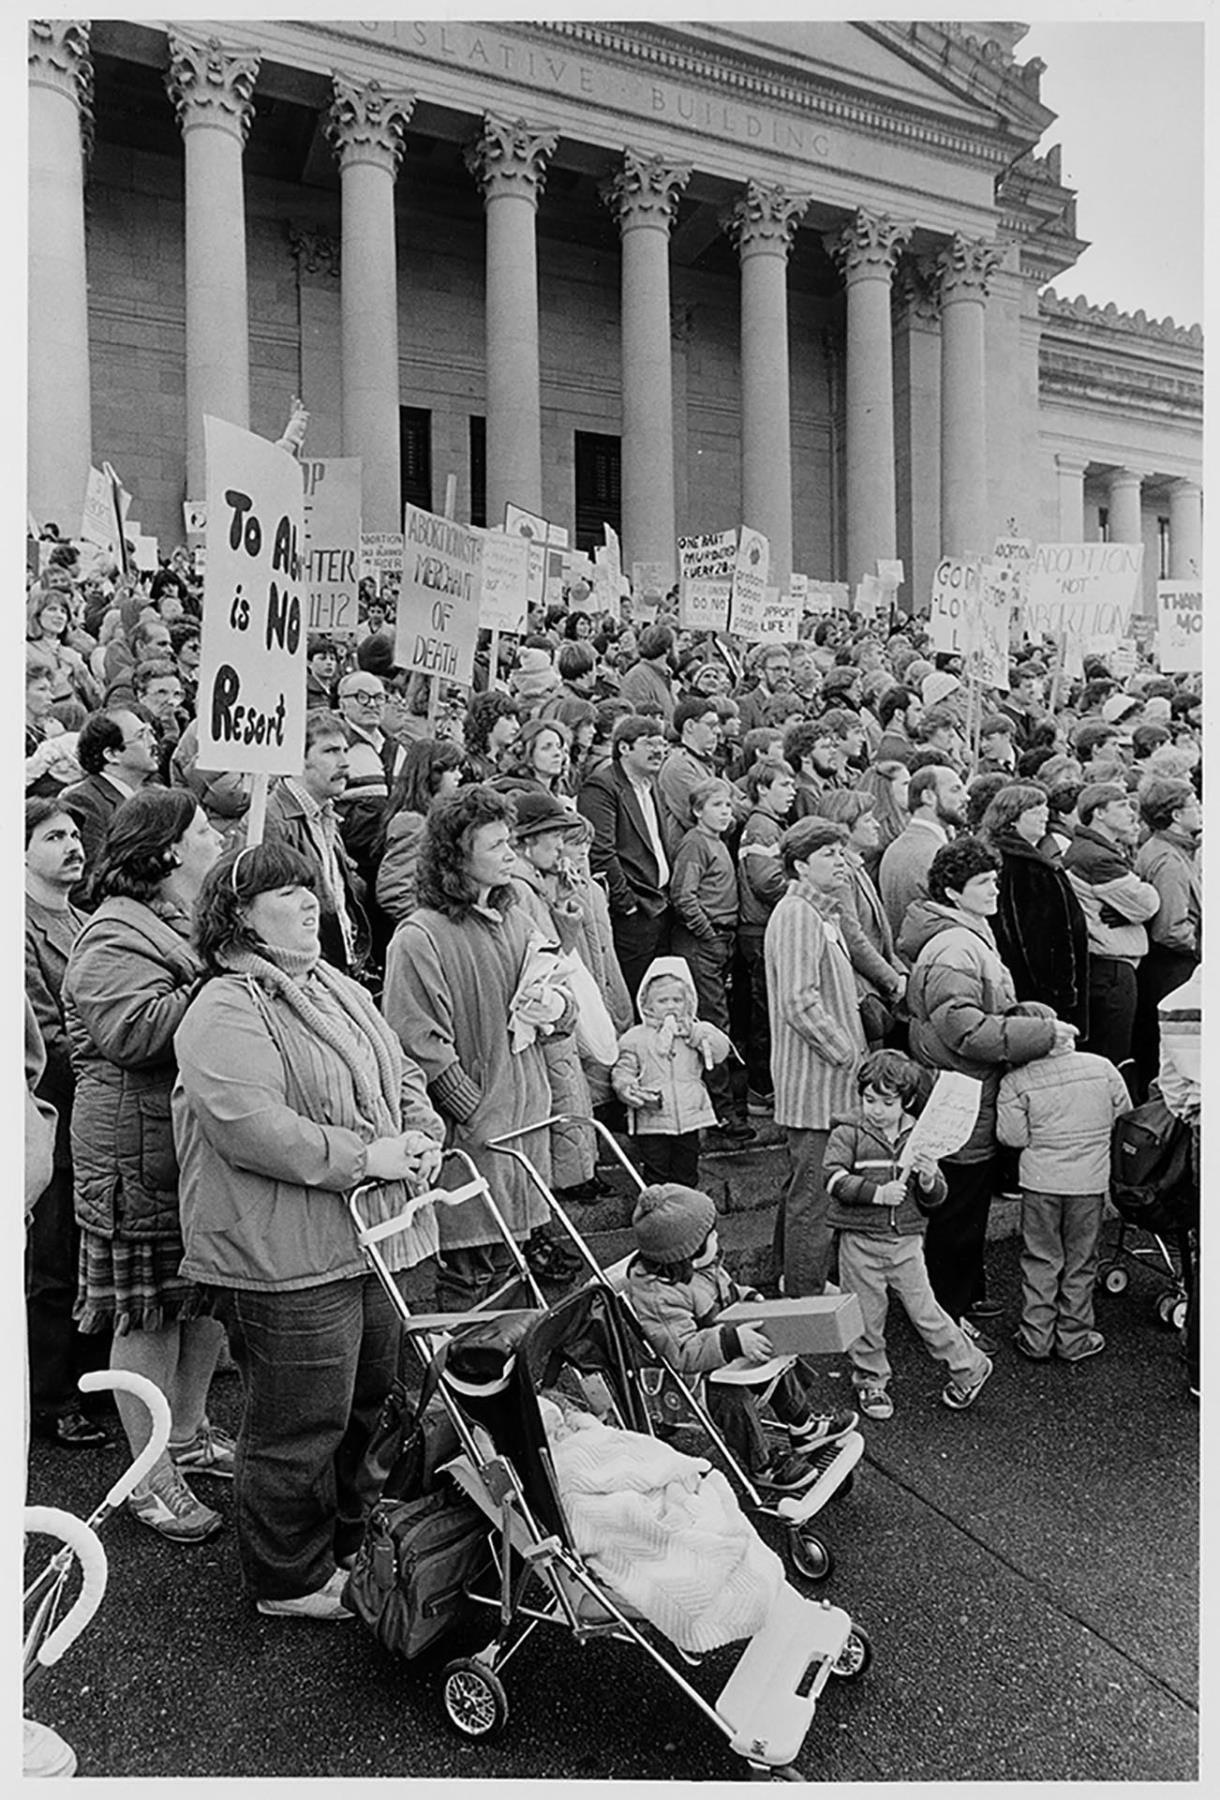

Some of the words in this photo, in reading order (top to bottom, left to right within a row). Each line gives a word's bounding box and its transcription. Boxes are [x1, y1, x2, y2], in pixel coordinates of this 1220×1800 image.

[652, 87, 830, 157] BUILDING
[224, 489, 262, 557] To
[414, 553, 475, 601] MERCHANT
[1032, 547, 1140, 574] ADOPTION
[230, 584, 250, 631] is
[266, 582, 301, 655] NO
[309, 592, 351, 628] 11-12
[431, 601, 454, 632] OF
[413, 635, 458, 676] DEATH
[211, 665, 287, 747] Resort
